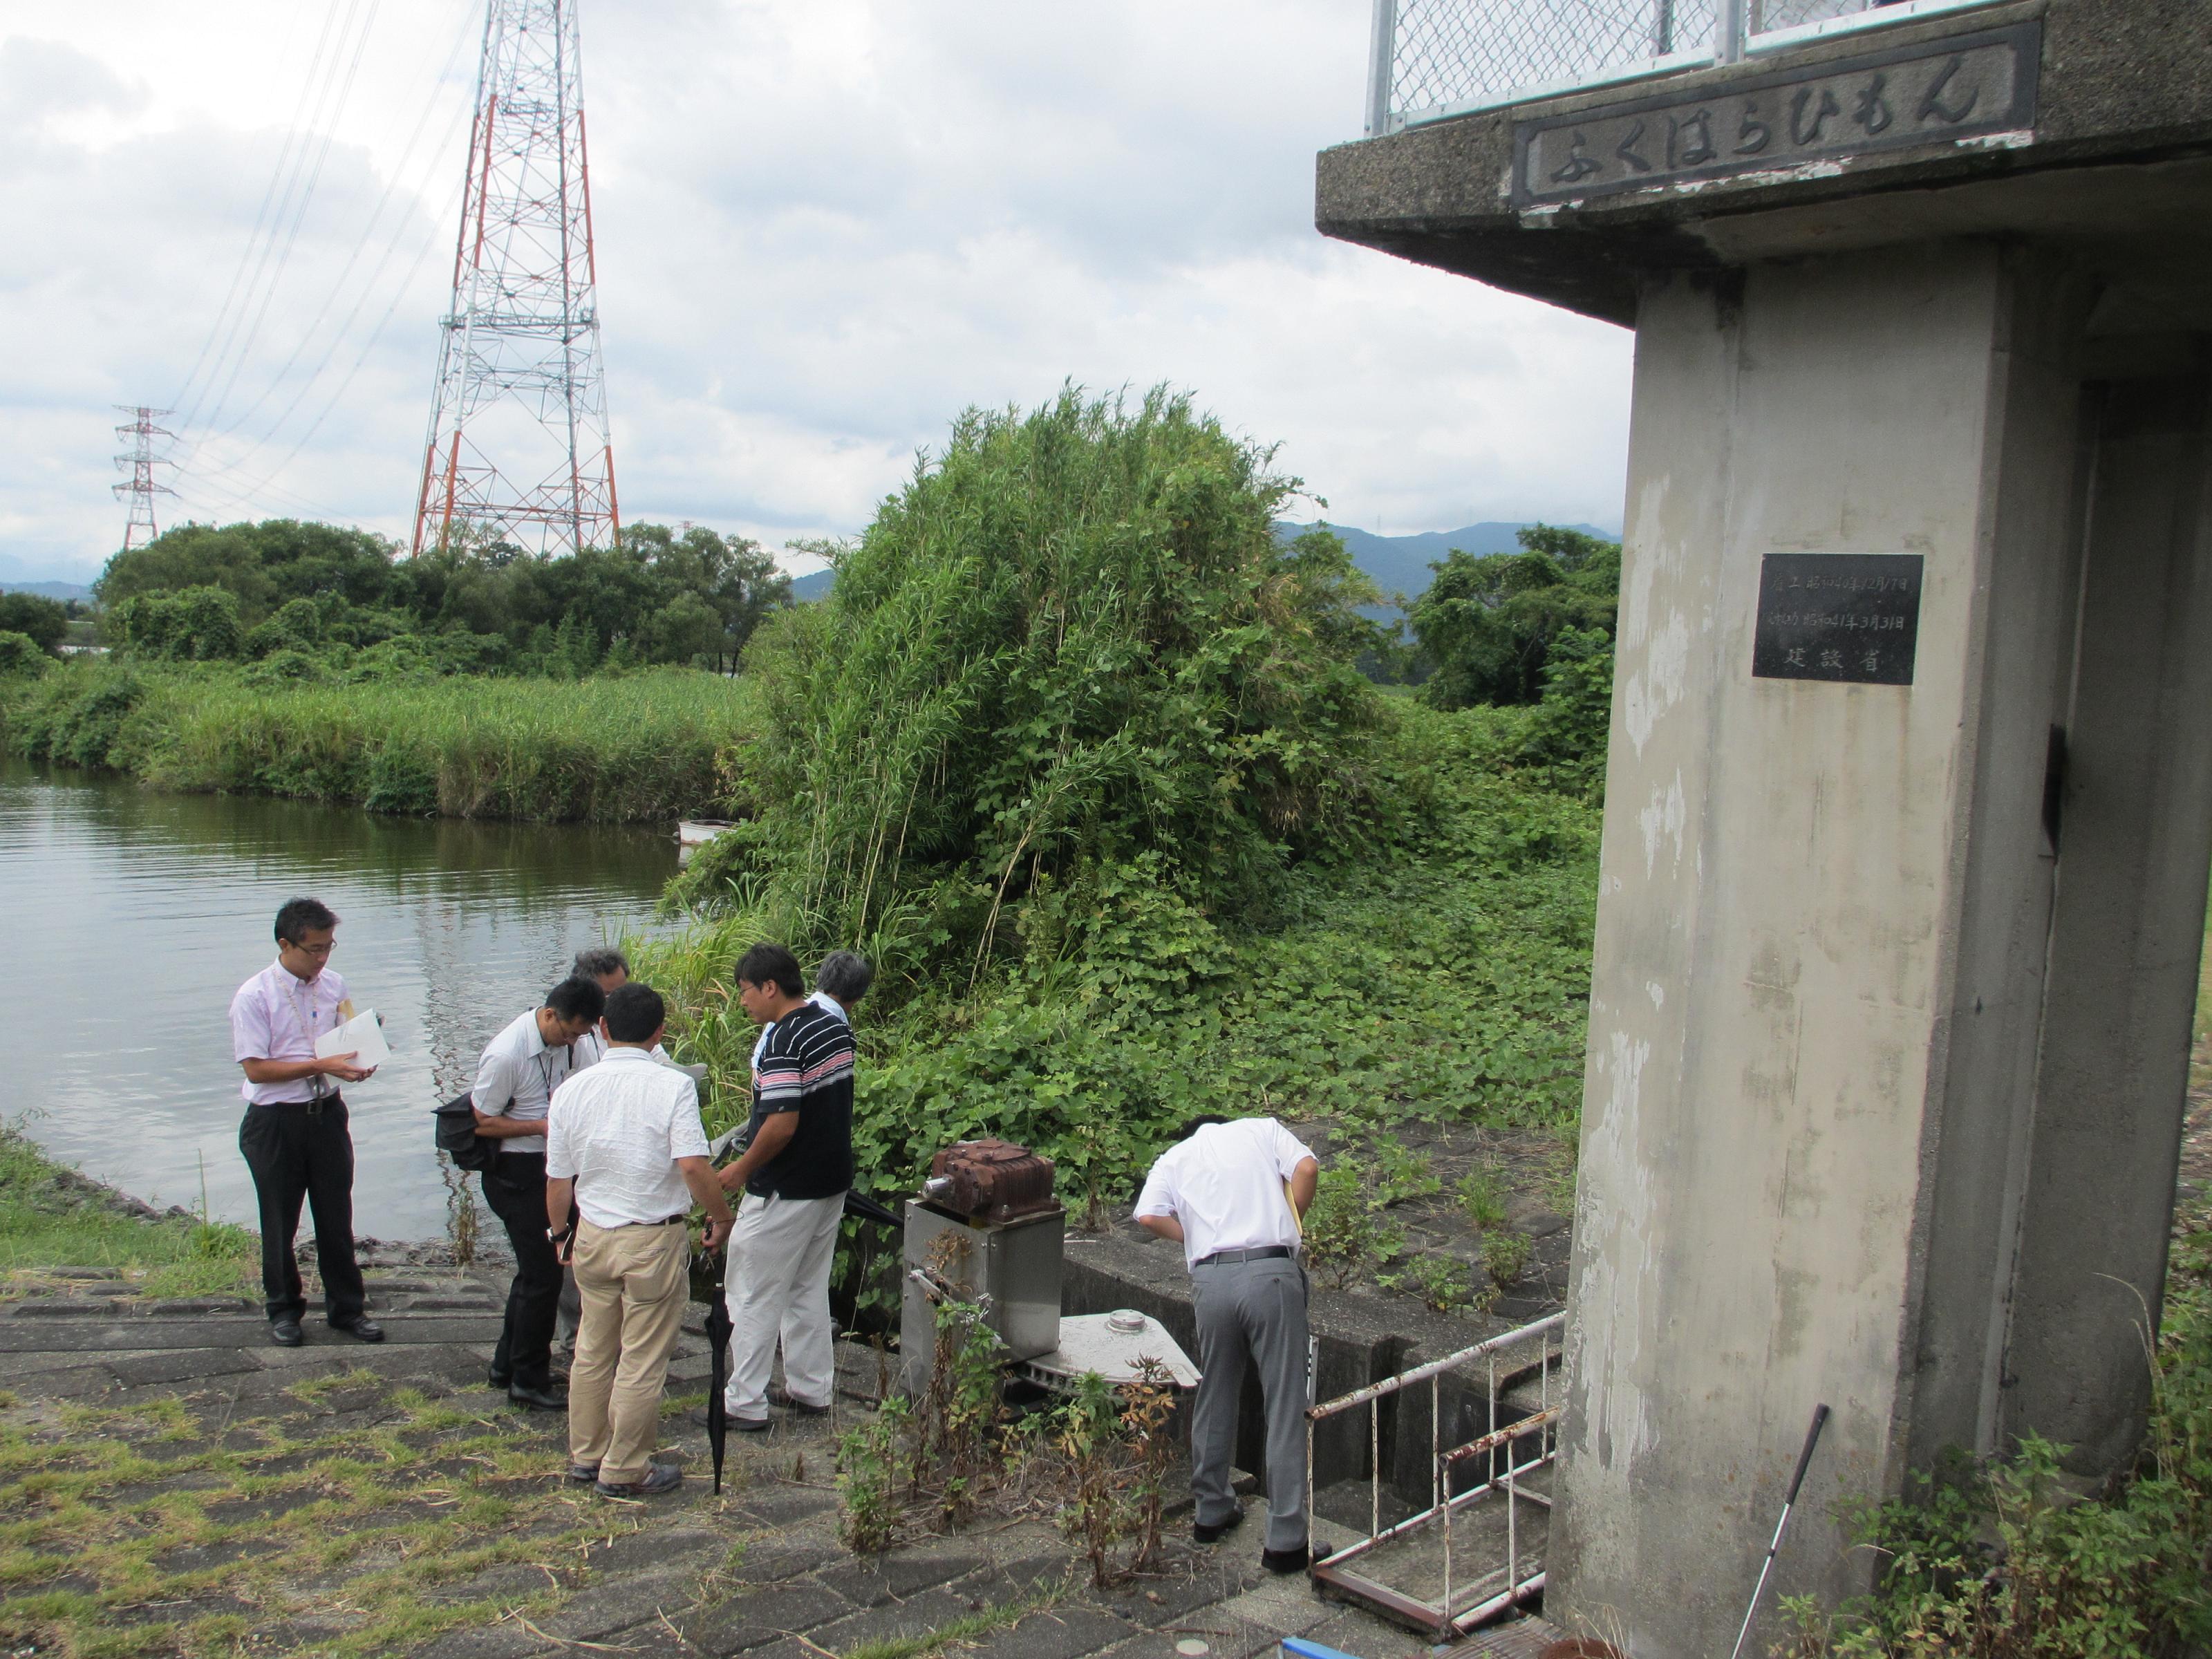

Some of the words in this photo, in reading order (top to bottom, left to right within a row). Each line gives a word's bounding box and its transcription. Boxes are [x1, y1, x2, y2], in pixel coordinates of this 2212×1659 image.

[1550, 55, 1980, 184] ふくはらひもん
[1783, 648, 1882, 673] 建設省
